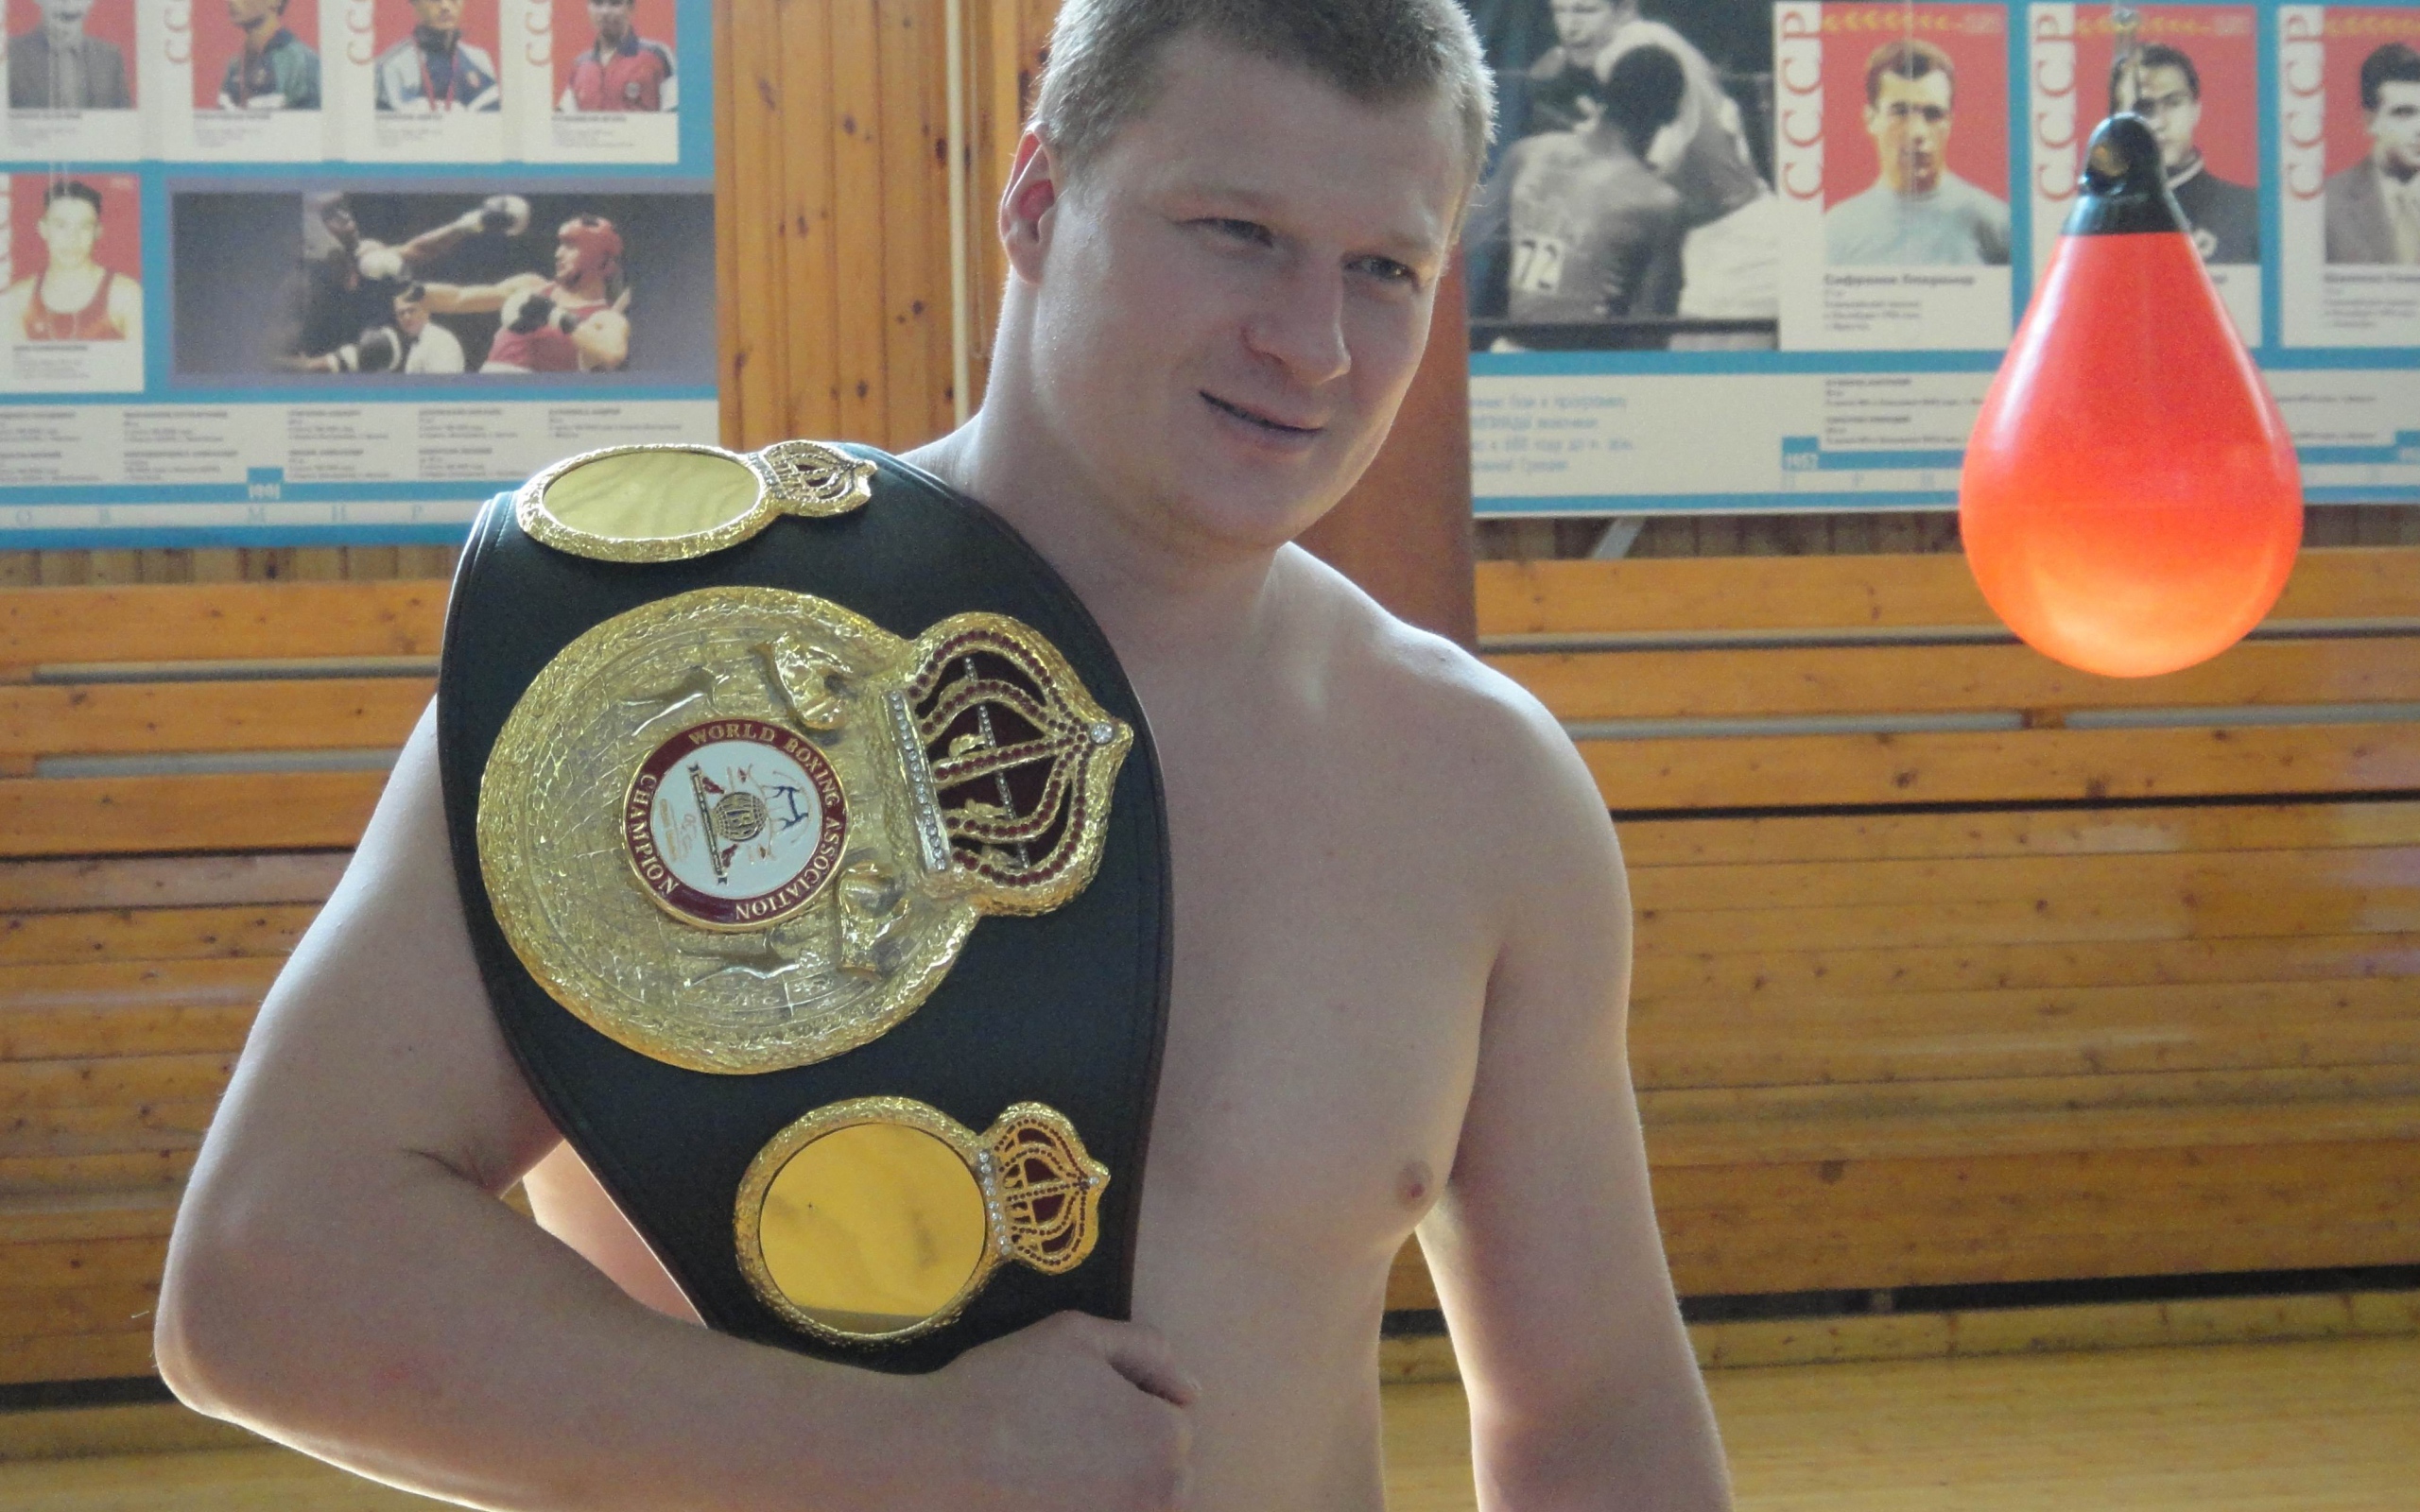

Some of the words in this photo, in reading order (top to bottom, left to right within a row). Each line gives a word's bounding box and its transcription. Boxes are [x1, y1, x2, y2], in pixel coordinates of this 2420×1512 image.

[1782, 9, 1823, 201] СССР
[2036, 13, 2077, 202] СССР
[2285, 14, 2325, 200] СССР
[688, 723, 776, 746] WORLD
[785, 737, 840, 806] BOXING
[630, 773, 681, 896] CHAMPION
[735, 816, 841, 920] ASSOCIATION
